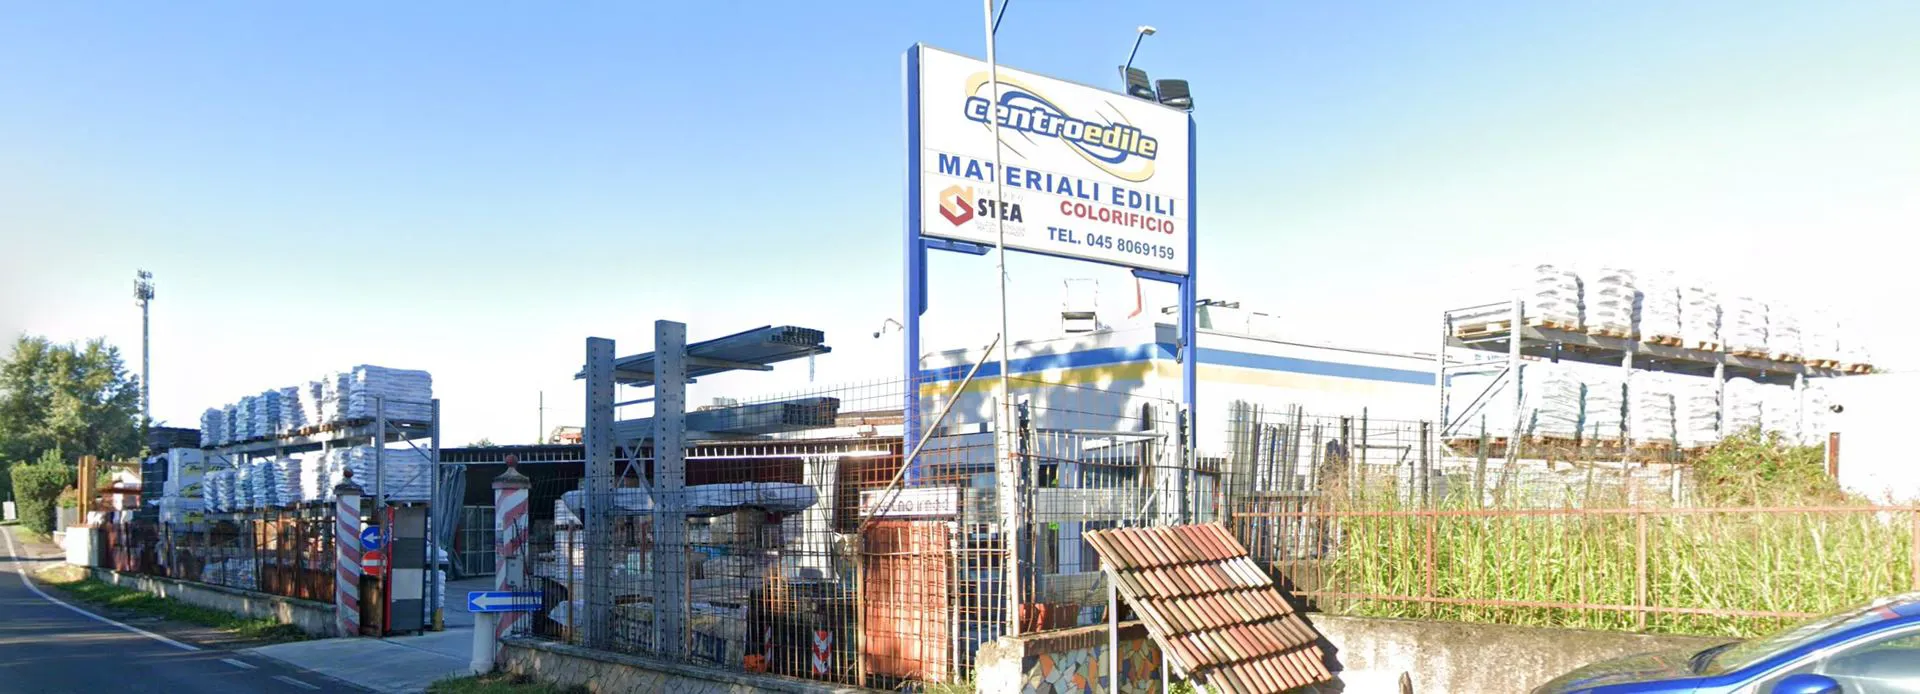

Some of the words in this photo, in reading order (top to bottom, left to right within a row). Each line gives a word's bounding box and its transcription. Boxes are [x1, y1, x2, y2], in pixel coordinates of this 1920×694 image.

[964, 95, 1158, 160] centroedile
[939, 153, 1099, 201] MATERIALI
[1112, 187, 1175, 216] EDILI
[978, 198, 1023, 223] STEA
[1060, 201, 1175, 234] COLORIFICIO
[1047, 227, 1081, 245] TEL.
[1086, 233, 1113, 249] 045
[1117, 238, 1175, 260] 8069159
